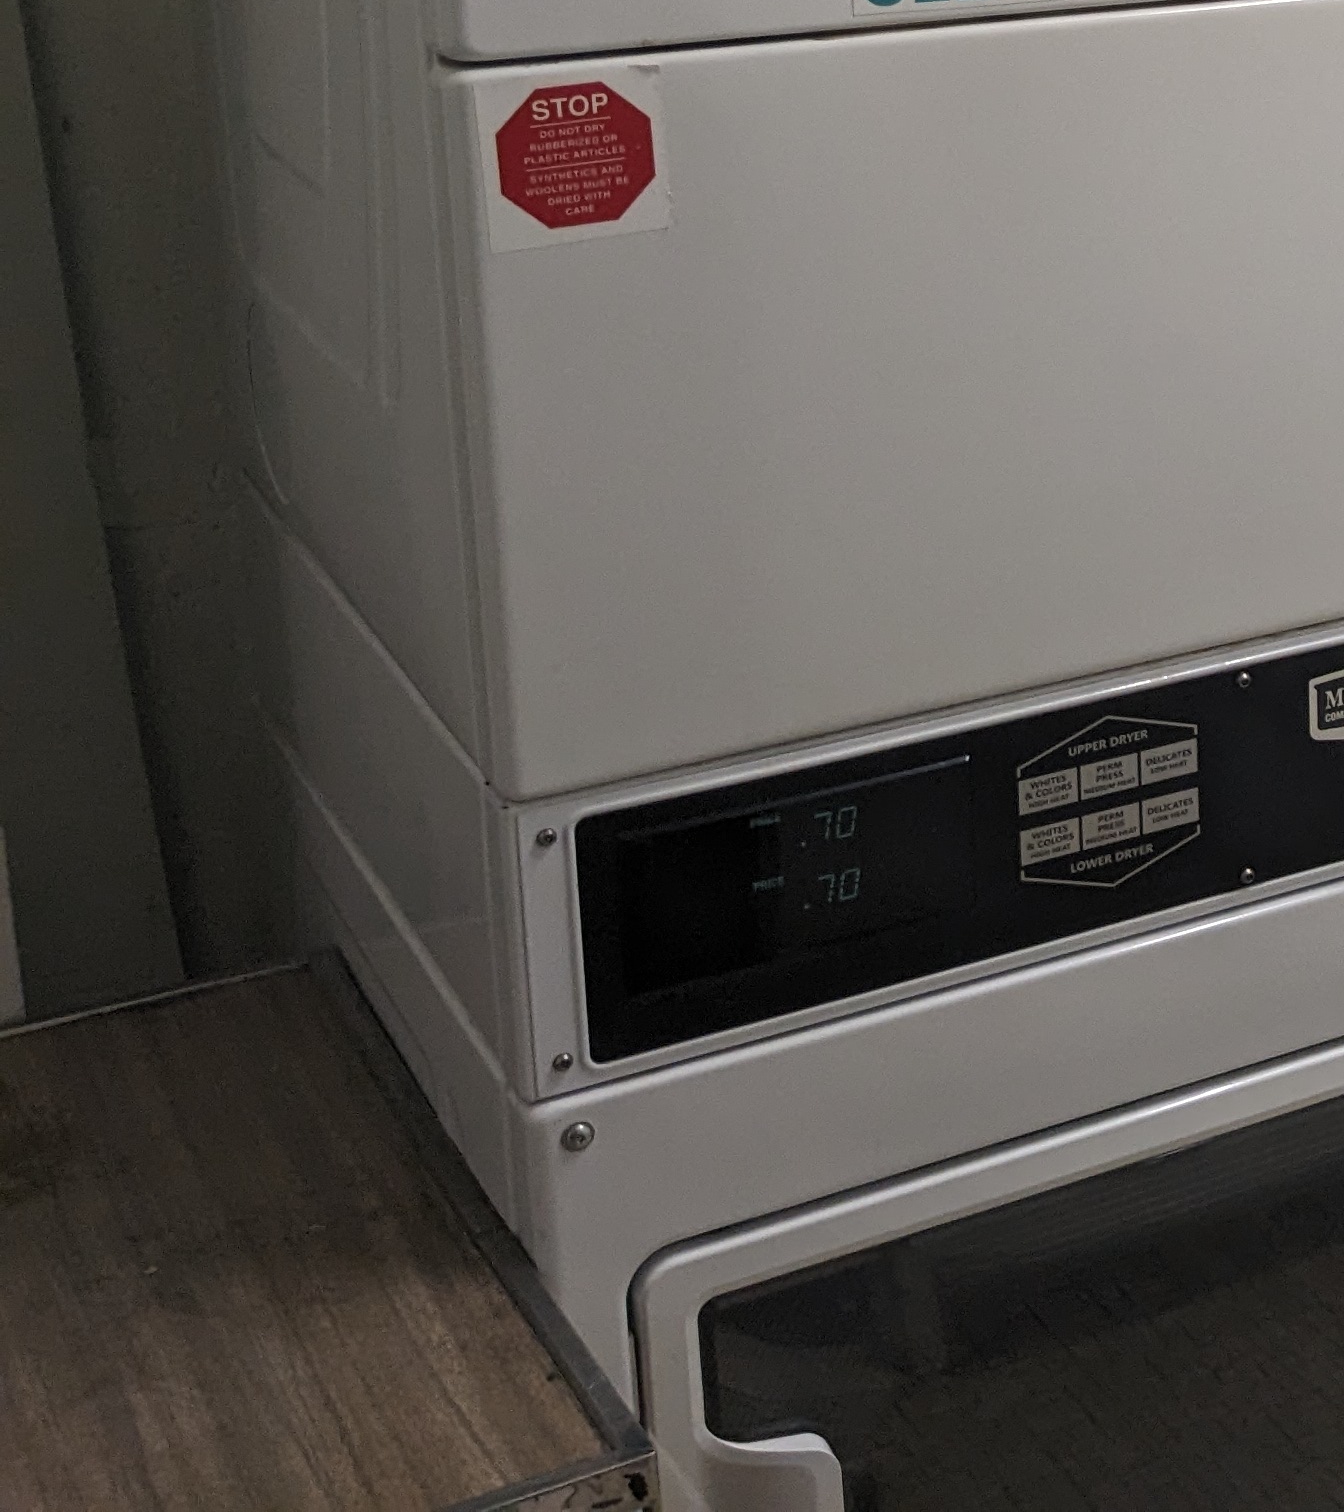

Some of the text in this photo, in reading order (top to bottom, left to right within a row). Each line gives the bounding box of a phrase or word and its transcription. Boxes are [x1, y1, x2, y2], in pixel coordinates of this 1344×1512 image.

[531, 92, 609, 121] STOP
[540, 123, 605, 140] DO NOT DRY
[529, 134, 618, 152] RUBBERIZED OR
[524, 145, 626, 165] PLASTIC ARTICLES
[529, 164, 623, 185] SYNTHETICS AND
[525, 175, 630, 197] WOOLENS MUST BE
[547, 190, 611, 206] DRIED WITH
[566, 204, 595, 216] CARE
[1068, 729, 1148, 757] UPPER DRYER
[1146, 748, 1192, 766] DELICATES
[1097, 760, 1122, 772] PERM
[1030, 774, 1066, 789] WHITES
[1095, 770, 1124, 783] PRESS
[1025, 782, 1072, 801] & COLORS
[1147, 797, 1194, 816] DELICATES
[1097, 810, 1124, 823] PERM
[1031, 825, 1068, 839] WHITES
[1097, 819, 1126, 832] PRESS
[1037, 832, 1075, 849] COLORS
[1070, 843, 1154, 874] LOWER DRYER
